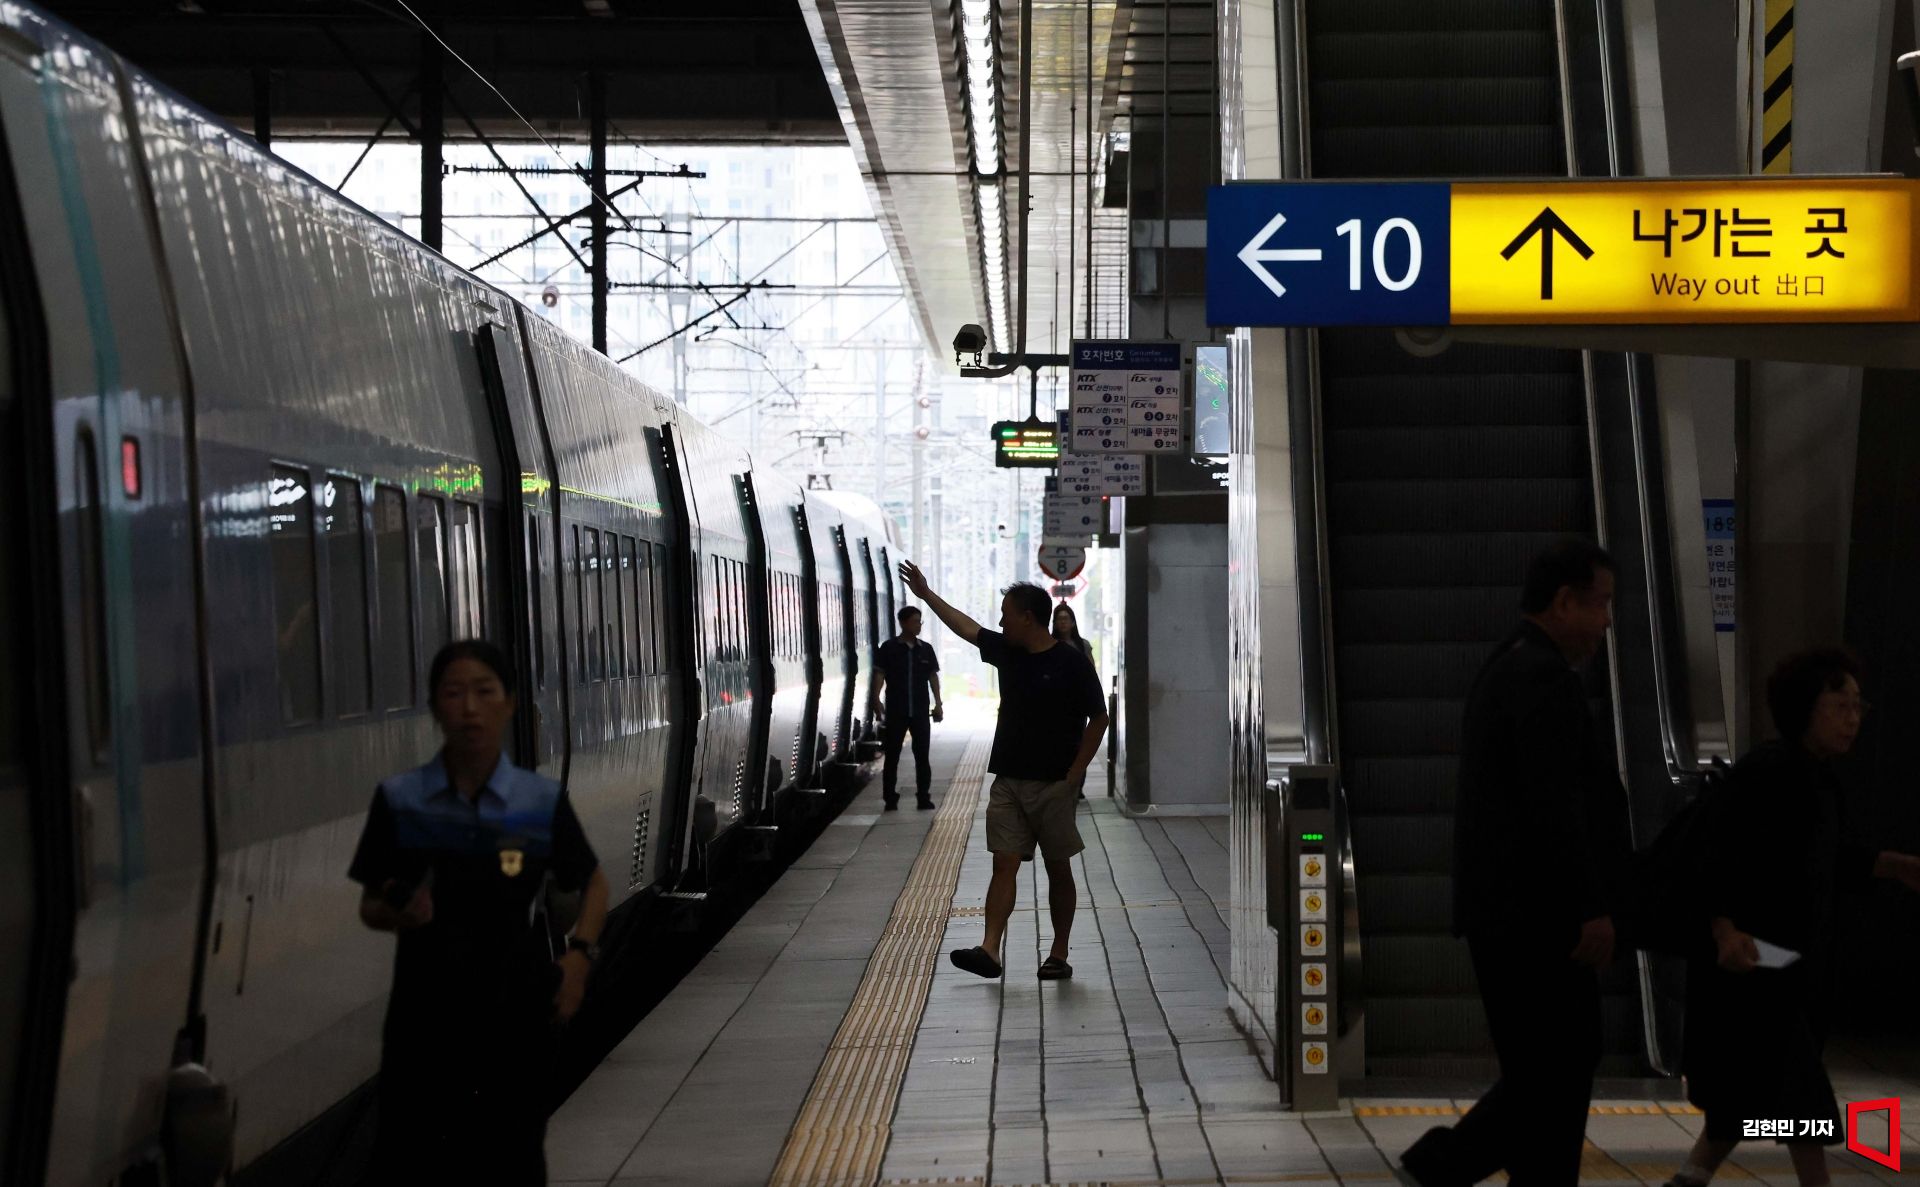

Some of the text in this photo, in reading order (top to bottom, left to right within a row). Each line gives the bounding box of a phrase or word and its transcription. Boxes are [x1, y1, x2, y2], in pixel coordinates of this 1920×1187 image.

[1632, 208, 1848, 260] 나가는 곳
[1335, 217, 1422, 292] 10
[1651, 273, 1760, 300] Way out
[1776, 274, 1825, 297] 出口
[1077, 374, 1099, 382] KTX
[1077, 406, 1096, 414] KTX
[1077, 428, 1097, 436] KTX
[1057, 559, 1067, 574] 8
